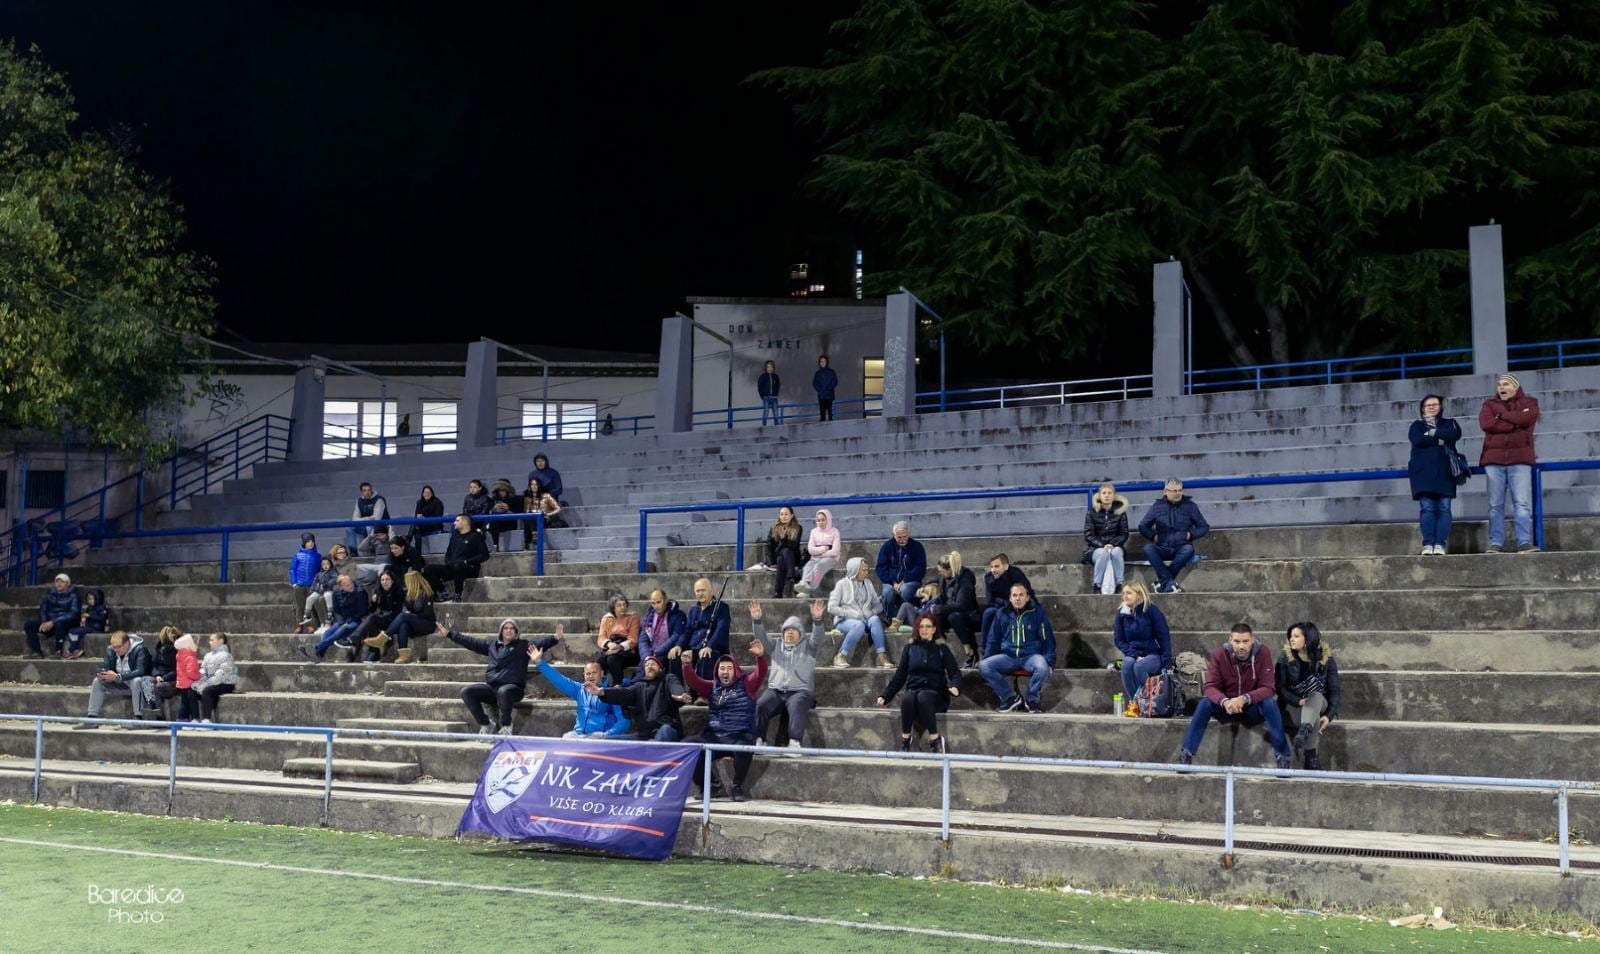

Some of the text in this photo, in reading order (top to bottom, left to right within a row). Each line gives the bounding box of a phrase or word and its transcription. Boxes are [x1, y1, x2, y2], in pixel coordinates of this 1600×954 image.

[729, 324, 753, 334] DOM
[758, 339, 800, 349] ZAMET
[540, 763, 679, 799] NK ZAMET
[549, 795, 654, 818] VIŠE OD KLUBA
